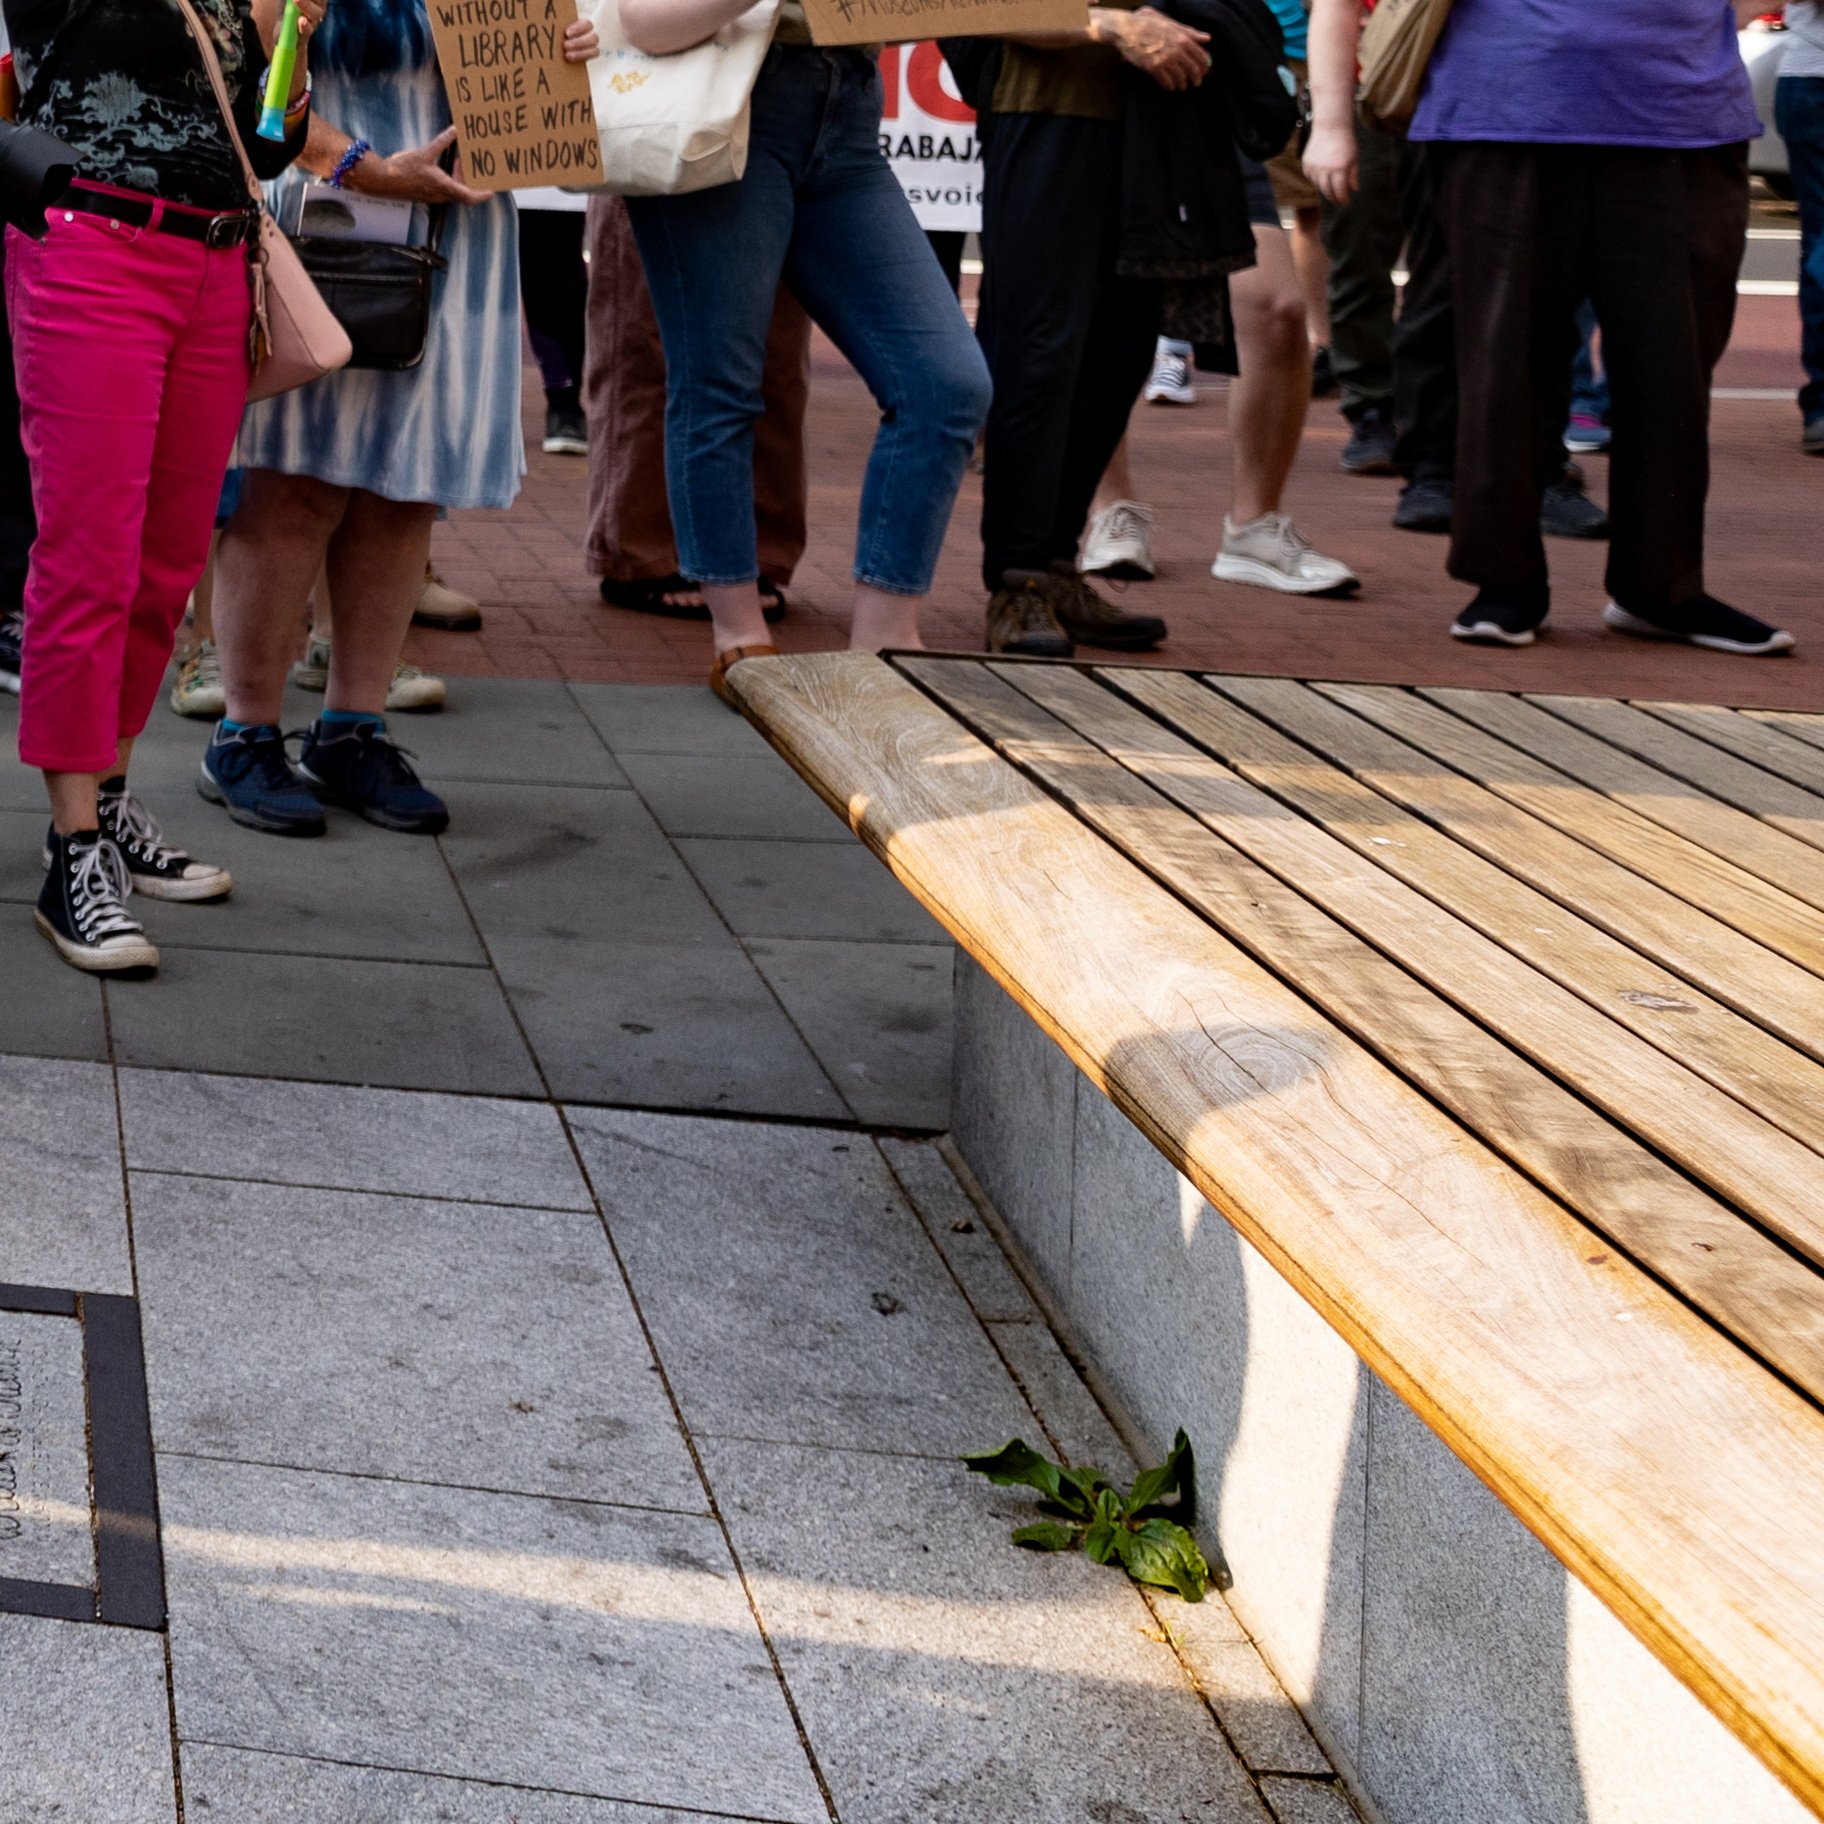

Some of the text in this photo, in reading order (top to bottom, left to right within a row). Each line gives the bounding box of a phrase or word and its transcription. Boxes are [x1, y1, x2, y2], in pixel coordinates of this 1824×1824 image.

[458, 24, 557, 69] LIBRARY
[455, 66, 551, 104] IS LIKE A
[463, 95, 594, 142] HOUSE WITH
[470, 137, 599, 180] NO WINDOWS
